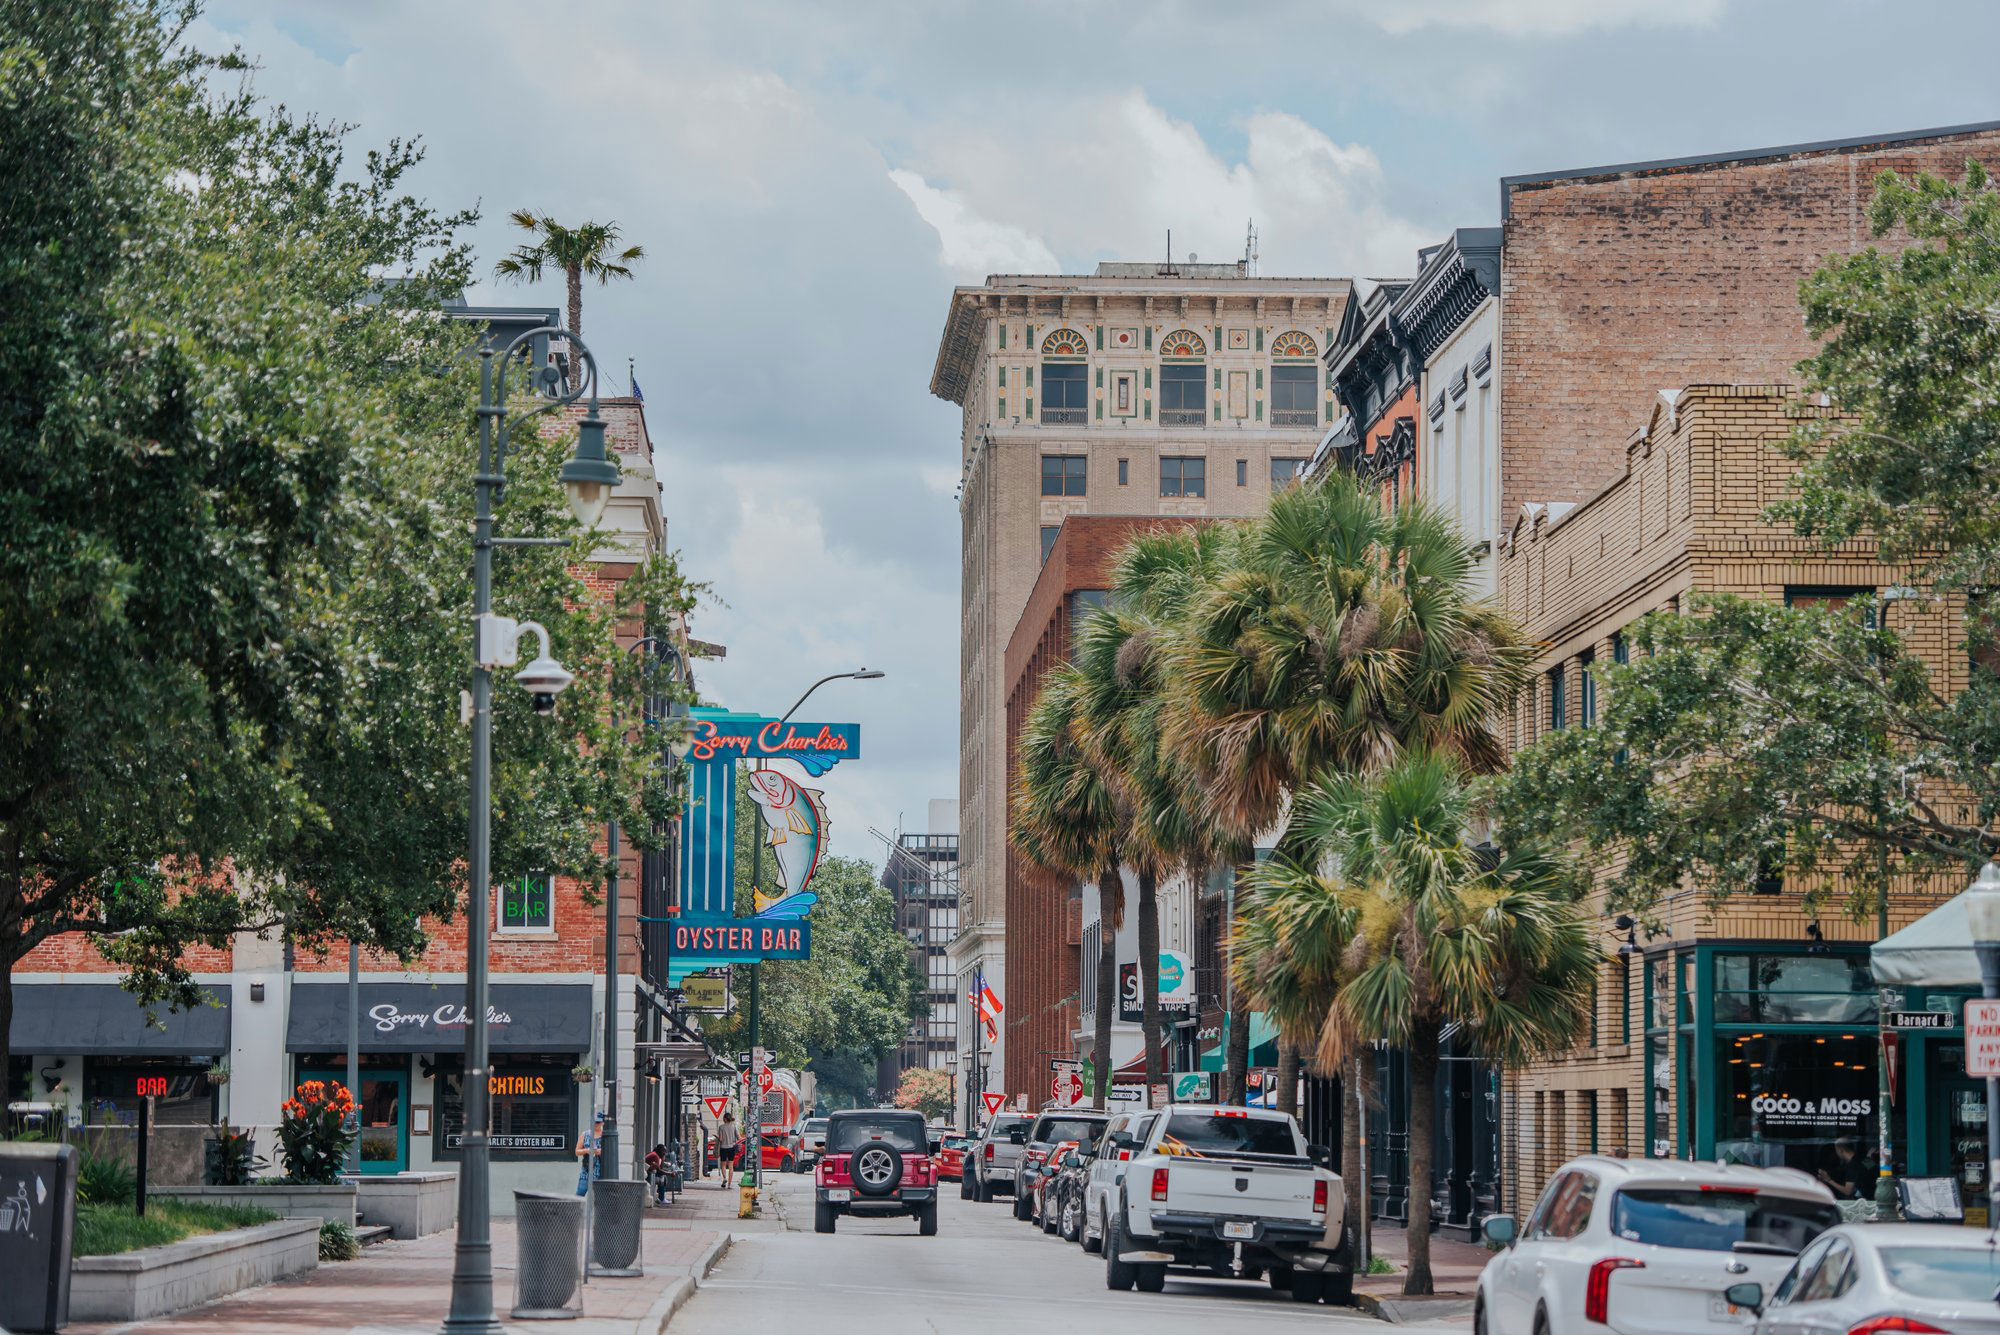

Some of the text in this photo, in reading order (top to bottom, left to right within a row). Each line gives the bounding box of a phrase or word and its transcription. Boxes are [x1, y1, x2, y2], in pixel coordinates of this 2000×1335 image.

[691, 720, 848, 760] Sorry Charlie's
[506, 901, 545, 917] BAR
[676, 926, 801, 951] OYSTER BAR
[1165, 1004, 1187, 1012] VAPE
[1980, 1008, 1998, 1021] NO
[369, 1004, 512, 1032] Sorry Chlie's
[1897, 1013, 1938, 1026] Barnard
[136, 1077, 167, 1097] BAR
[1751, 1097, 1871, 1114] COCO & MOSS
[514, 1137, 540, 1146] OYSTER
[541, 1138, 556, 1146] BAR
